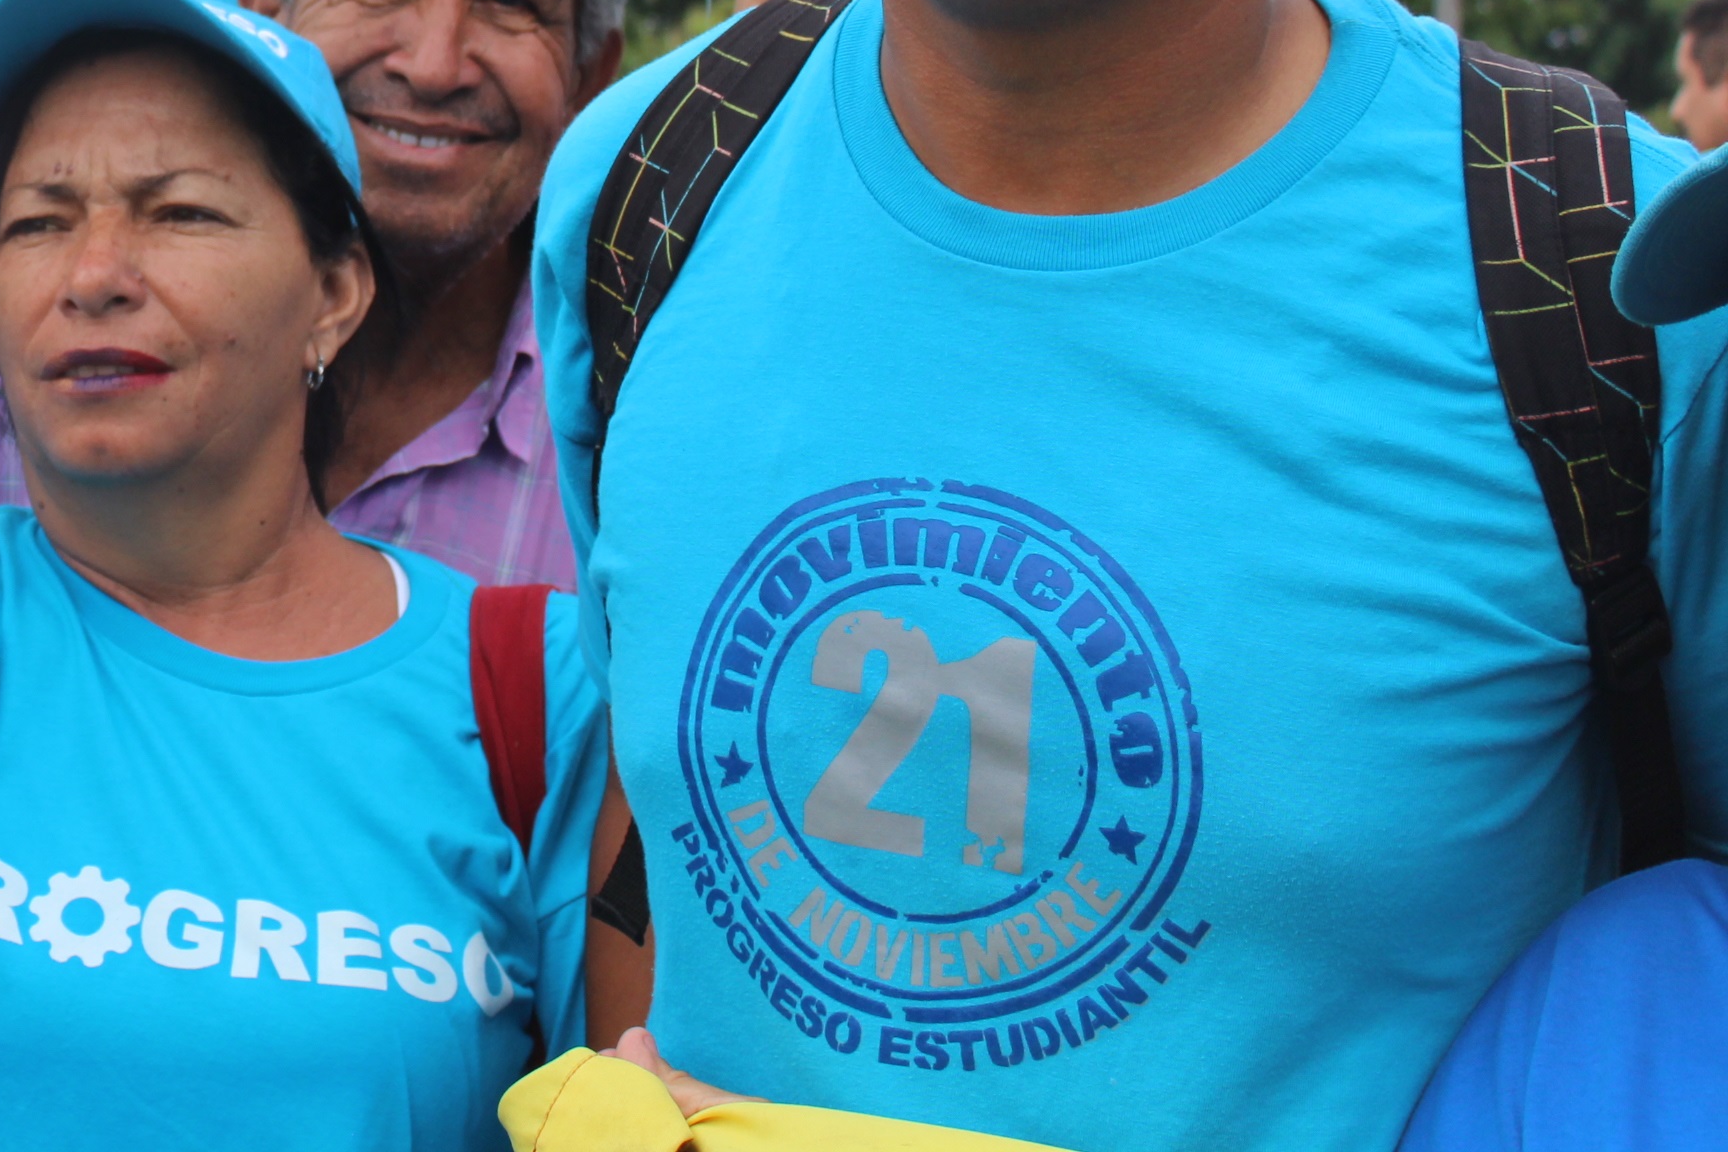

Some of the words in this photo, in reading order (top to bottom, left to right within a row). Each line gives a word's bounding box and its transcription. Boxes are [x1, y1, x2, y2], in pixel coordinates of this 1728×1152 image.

[802, 610, 1039, 876] 21
[672, 821, 863, 1055] PROGRESO
[878, 914, 1213, 1072] ESTUDIANTIL
[728, 799, 798, 889] DE
[789, 862, 1123, 989] NOVIEMBRE
